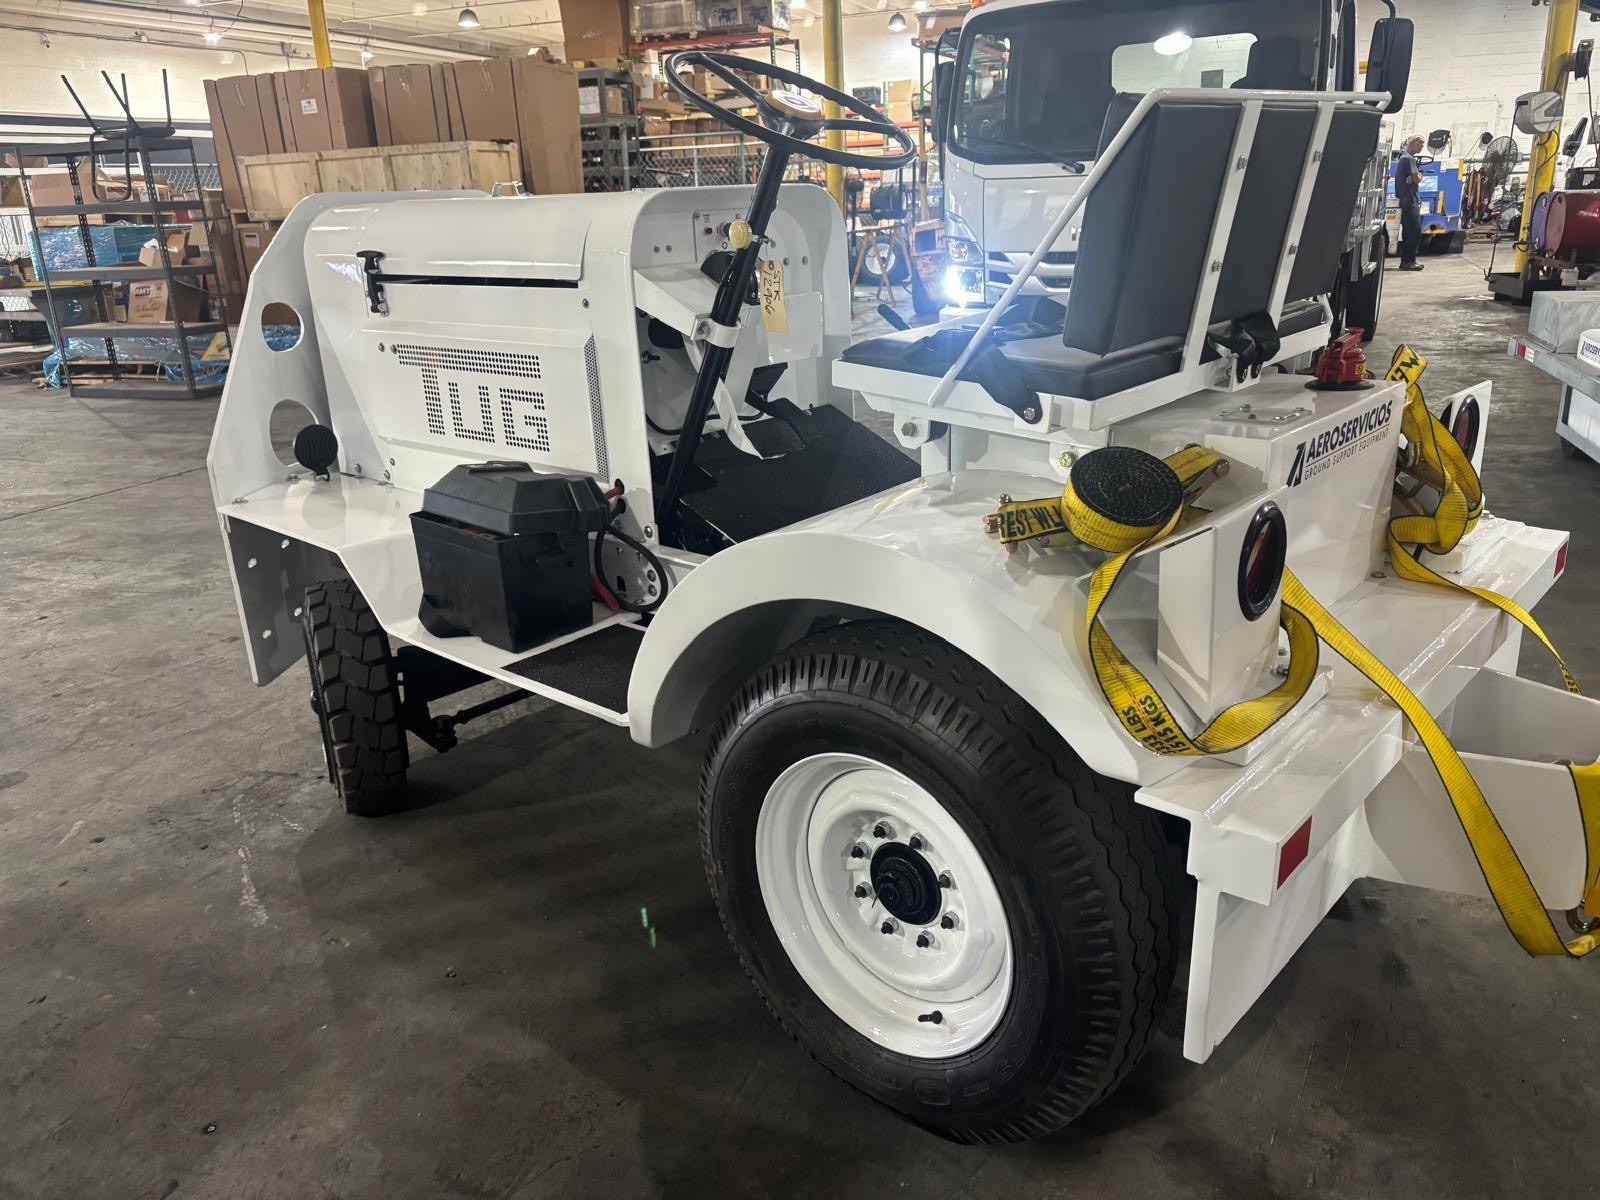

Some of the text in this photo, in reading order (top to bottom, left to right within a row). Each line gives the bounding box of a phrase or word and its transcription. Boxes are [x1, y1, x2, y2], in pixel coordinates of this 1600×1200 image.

[773, 270, 781, 301] STK
[396, 343, 551, 452] TUG
[1306, 400, 1393, 463] AEROSERVICIOS
[1304, 427, 1390, 481] GROUND SUPPORT EQUIPMENT
[1121, 705, 1148, 733] LBS
[1139, 695, 1165, 727] KGS
